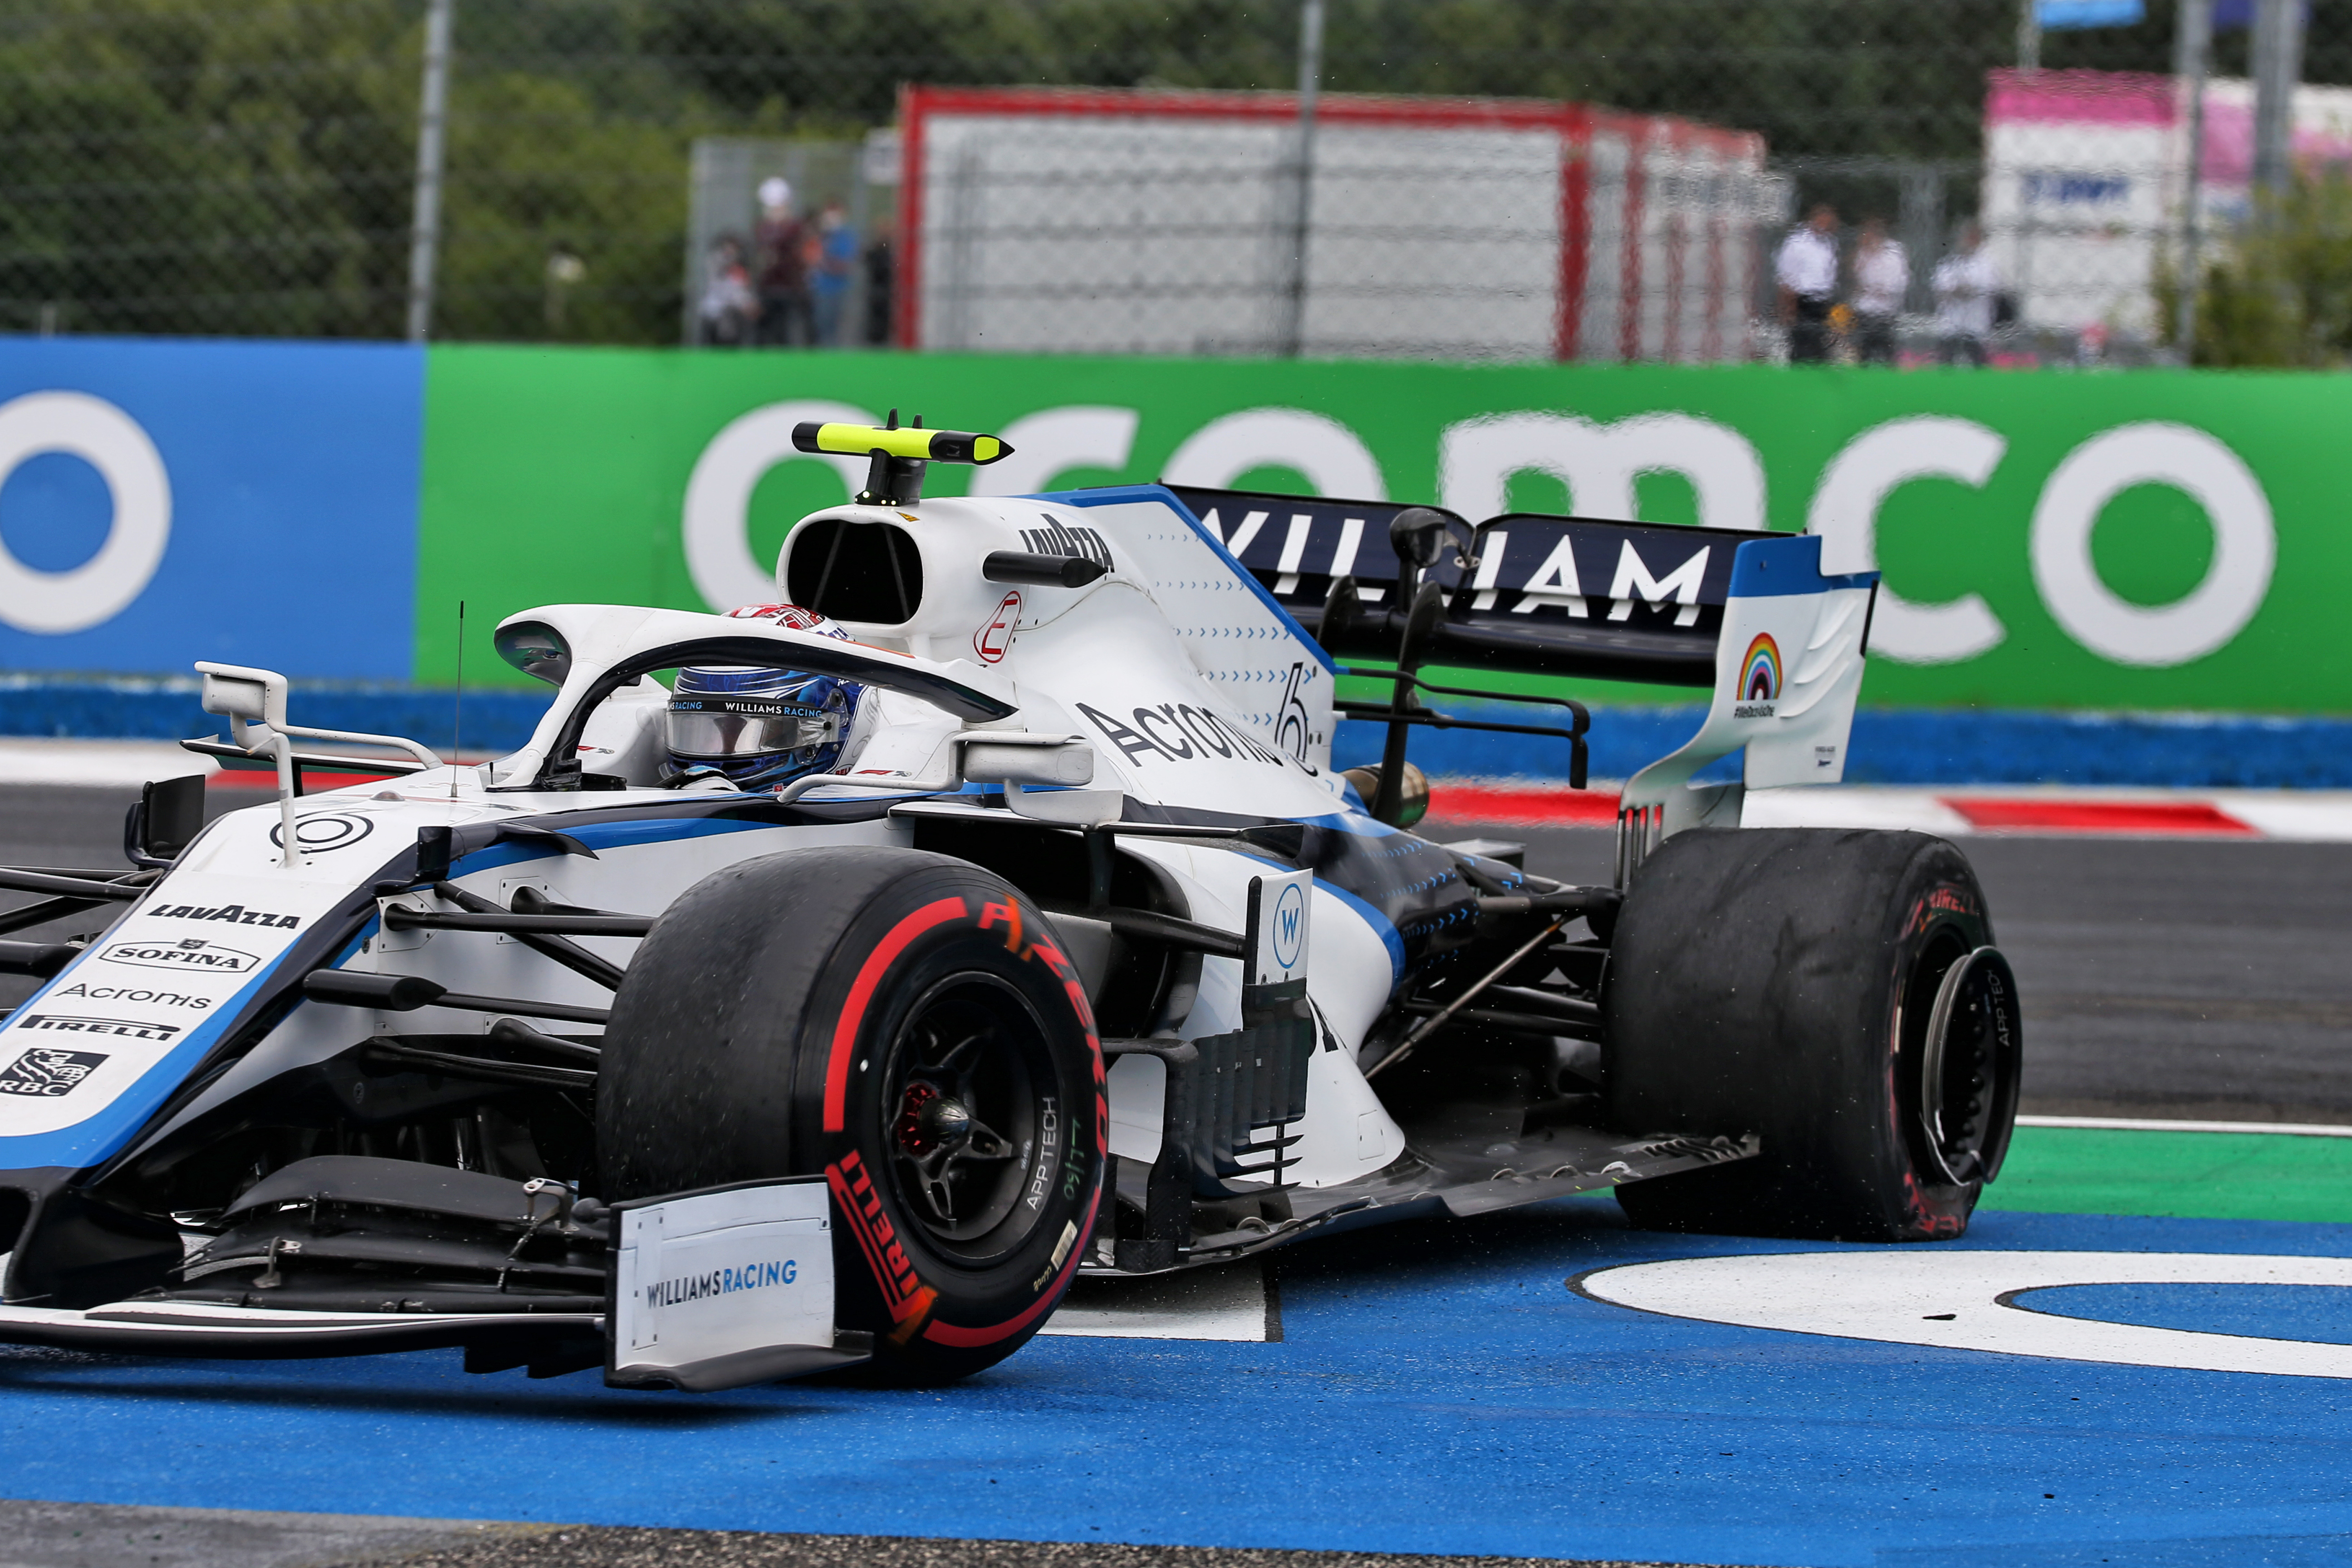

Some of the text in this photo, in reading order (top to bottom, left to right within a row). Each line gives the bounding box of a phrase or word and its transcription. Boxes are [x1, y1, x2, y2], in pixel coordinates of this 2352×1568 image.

[981, 598, 1018, 655] E
[675, 701, 703, 710] RACING
[725, 702, 823, 718] WILLIAMS RACING
[1075, 702, 1284, 767] Acronis
[146, 905, 302, 929] LAVAZZA
[1282, 907, 1299, 945] W
[113, 947, 241, 970] SOFINA
[54, 983, 212, 1009] Acronis
[18, 1014, 181, 1041] PIRELLI
[1031, 933, 1107, 1162] ZERO
[0, 1080, 68, 1095] RBC
[824, 1149, 929, 1324] PIRELLI
[647, 1259, 798, 1309] WILLIAMS RACING
